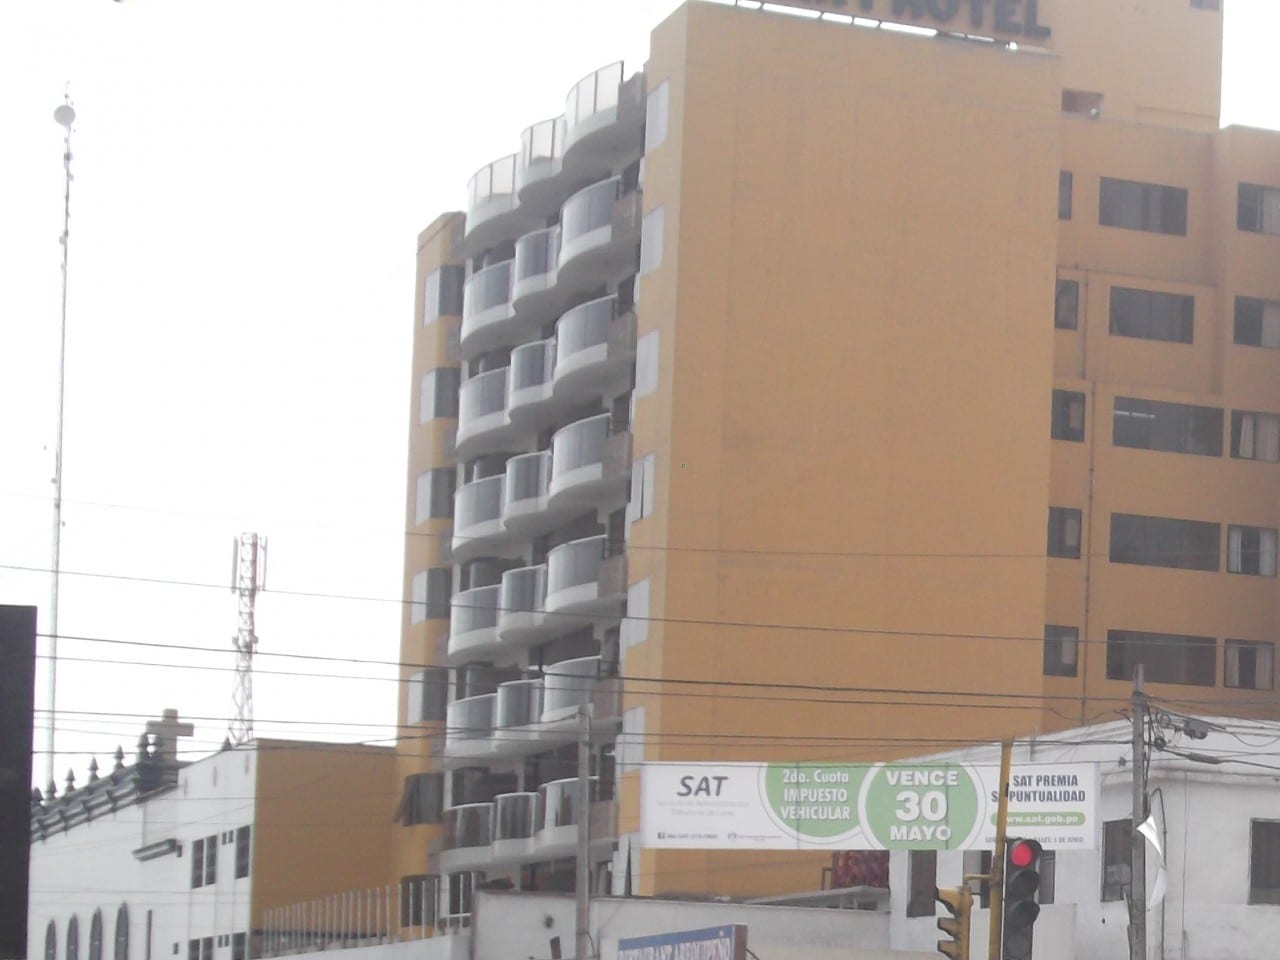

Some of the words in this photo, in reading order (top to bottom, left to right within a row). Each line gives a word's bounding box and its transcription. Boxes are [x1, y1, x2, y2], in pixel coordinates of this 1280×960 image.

[783, 769, 810, 784] 2da.
[814, 769, 849, 784] Cuota
[885, 770, 958, 786] VENCE
[1013, 774, 1033, 787] SAT
[1036, 774, 1079, 787] PREMIA
[677, 775, 729, 797] SAT
[784, 788, 848, 802] IMPUESTO
[1009, 790, 1086, 802] PUNTUALIDAD
[780, 805, 851, 820] VEHICULAR
[895, 790, 948, 822] 30
[890, 826, 951, 841] MAYO
